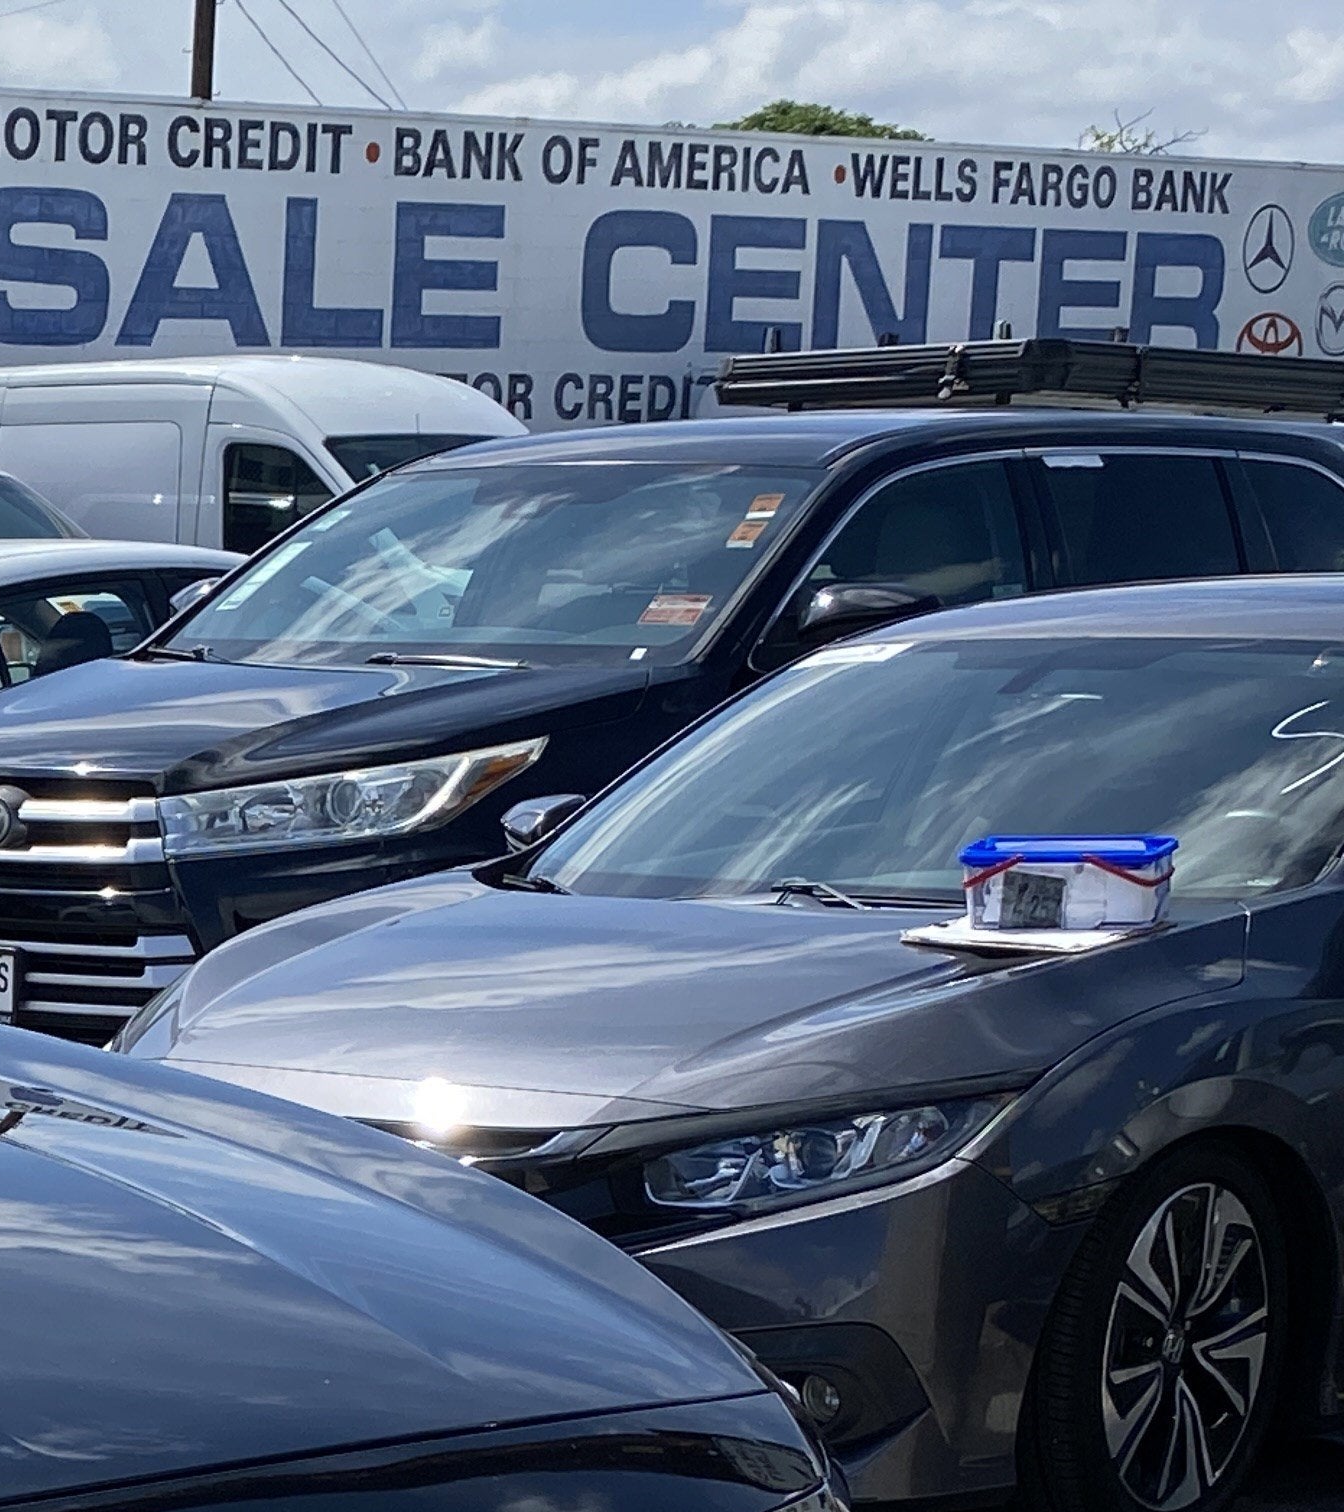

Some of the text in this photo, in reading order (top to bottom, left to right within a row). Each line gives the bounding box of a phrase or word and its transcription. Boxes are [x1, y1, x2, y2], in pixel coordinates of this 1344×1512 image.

[167, 115, 353, 174] CREDIT
[394, 127, 526, 182] BANK
[542, 135, 600, 186] OF
[611, 139, 811, 196] AMERICA
[850, 153, 978, 203] WELLS
[992, 161, 1117, 210] FARGO
[1131, 167, 1233, 215] BANK
[580, 209, 1226, 354] CENTER
